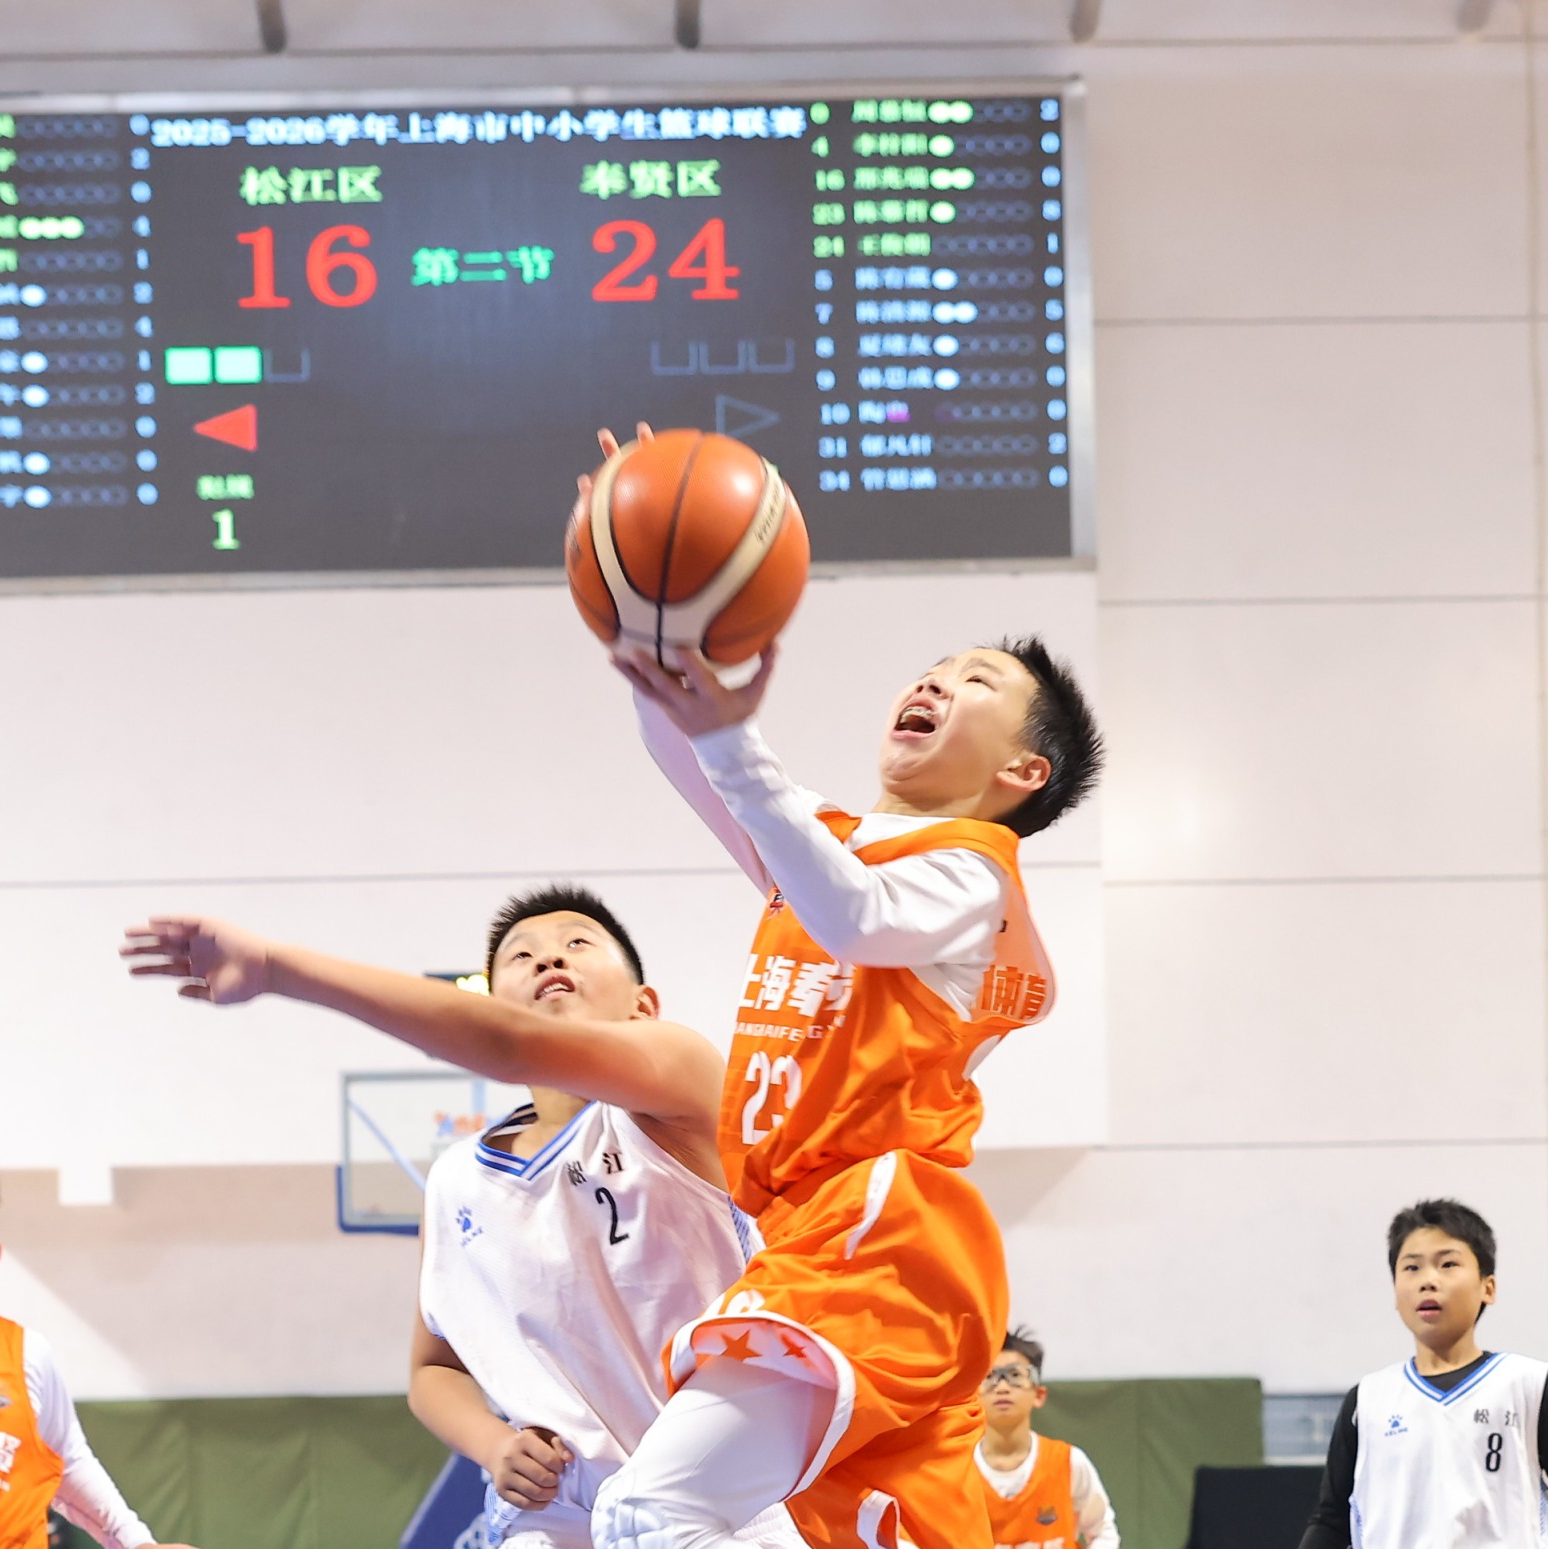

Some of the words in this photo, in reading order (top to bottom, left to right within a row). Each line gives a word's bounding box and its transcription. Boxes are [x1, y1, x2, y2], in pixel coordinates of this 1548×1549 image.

[239, 166, 383, 206] 松江区
[236, 225, 379, 309] 16
[410, 245, 555, 286] 第二节
[592, 217, 741, 302] 24
[211, 508, 242, 550] 1
[594, 1187, 630, 1246] 2
[1485, 1432, 1503, 1473] 8
